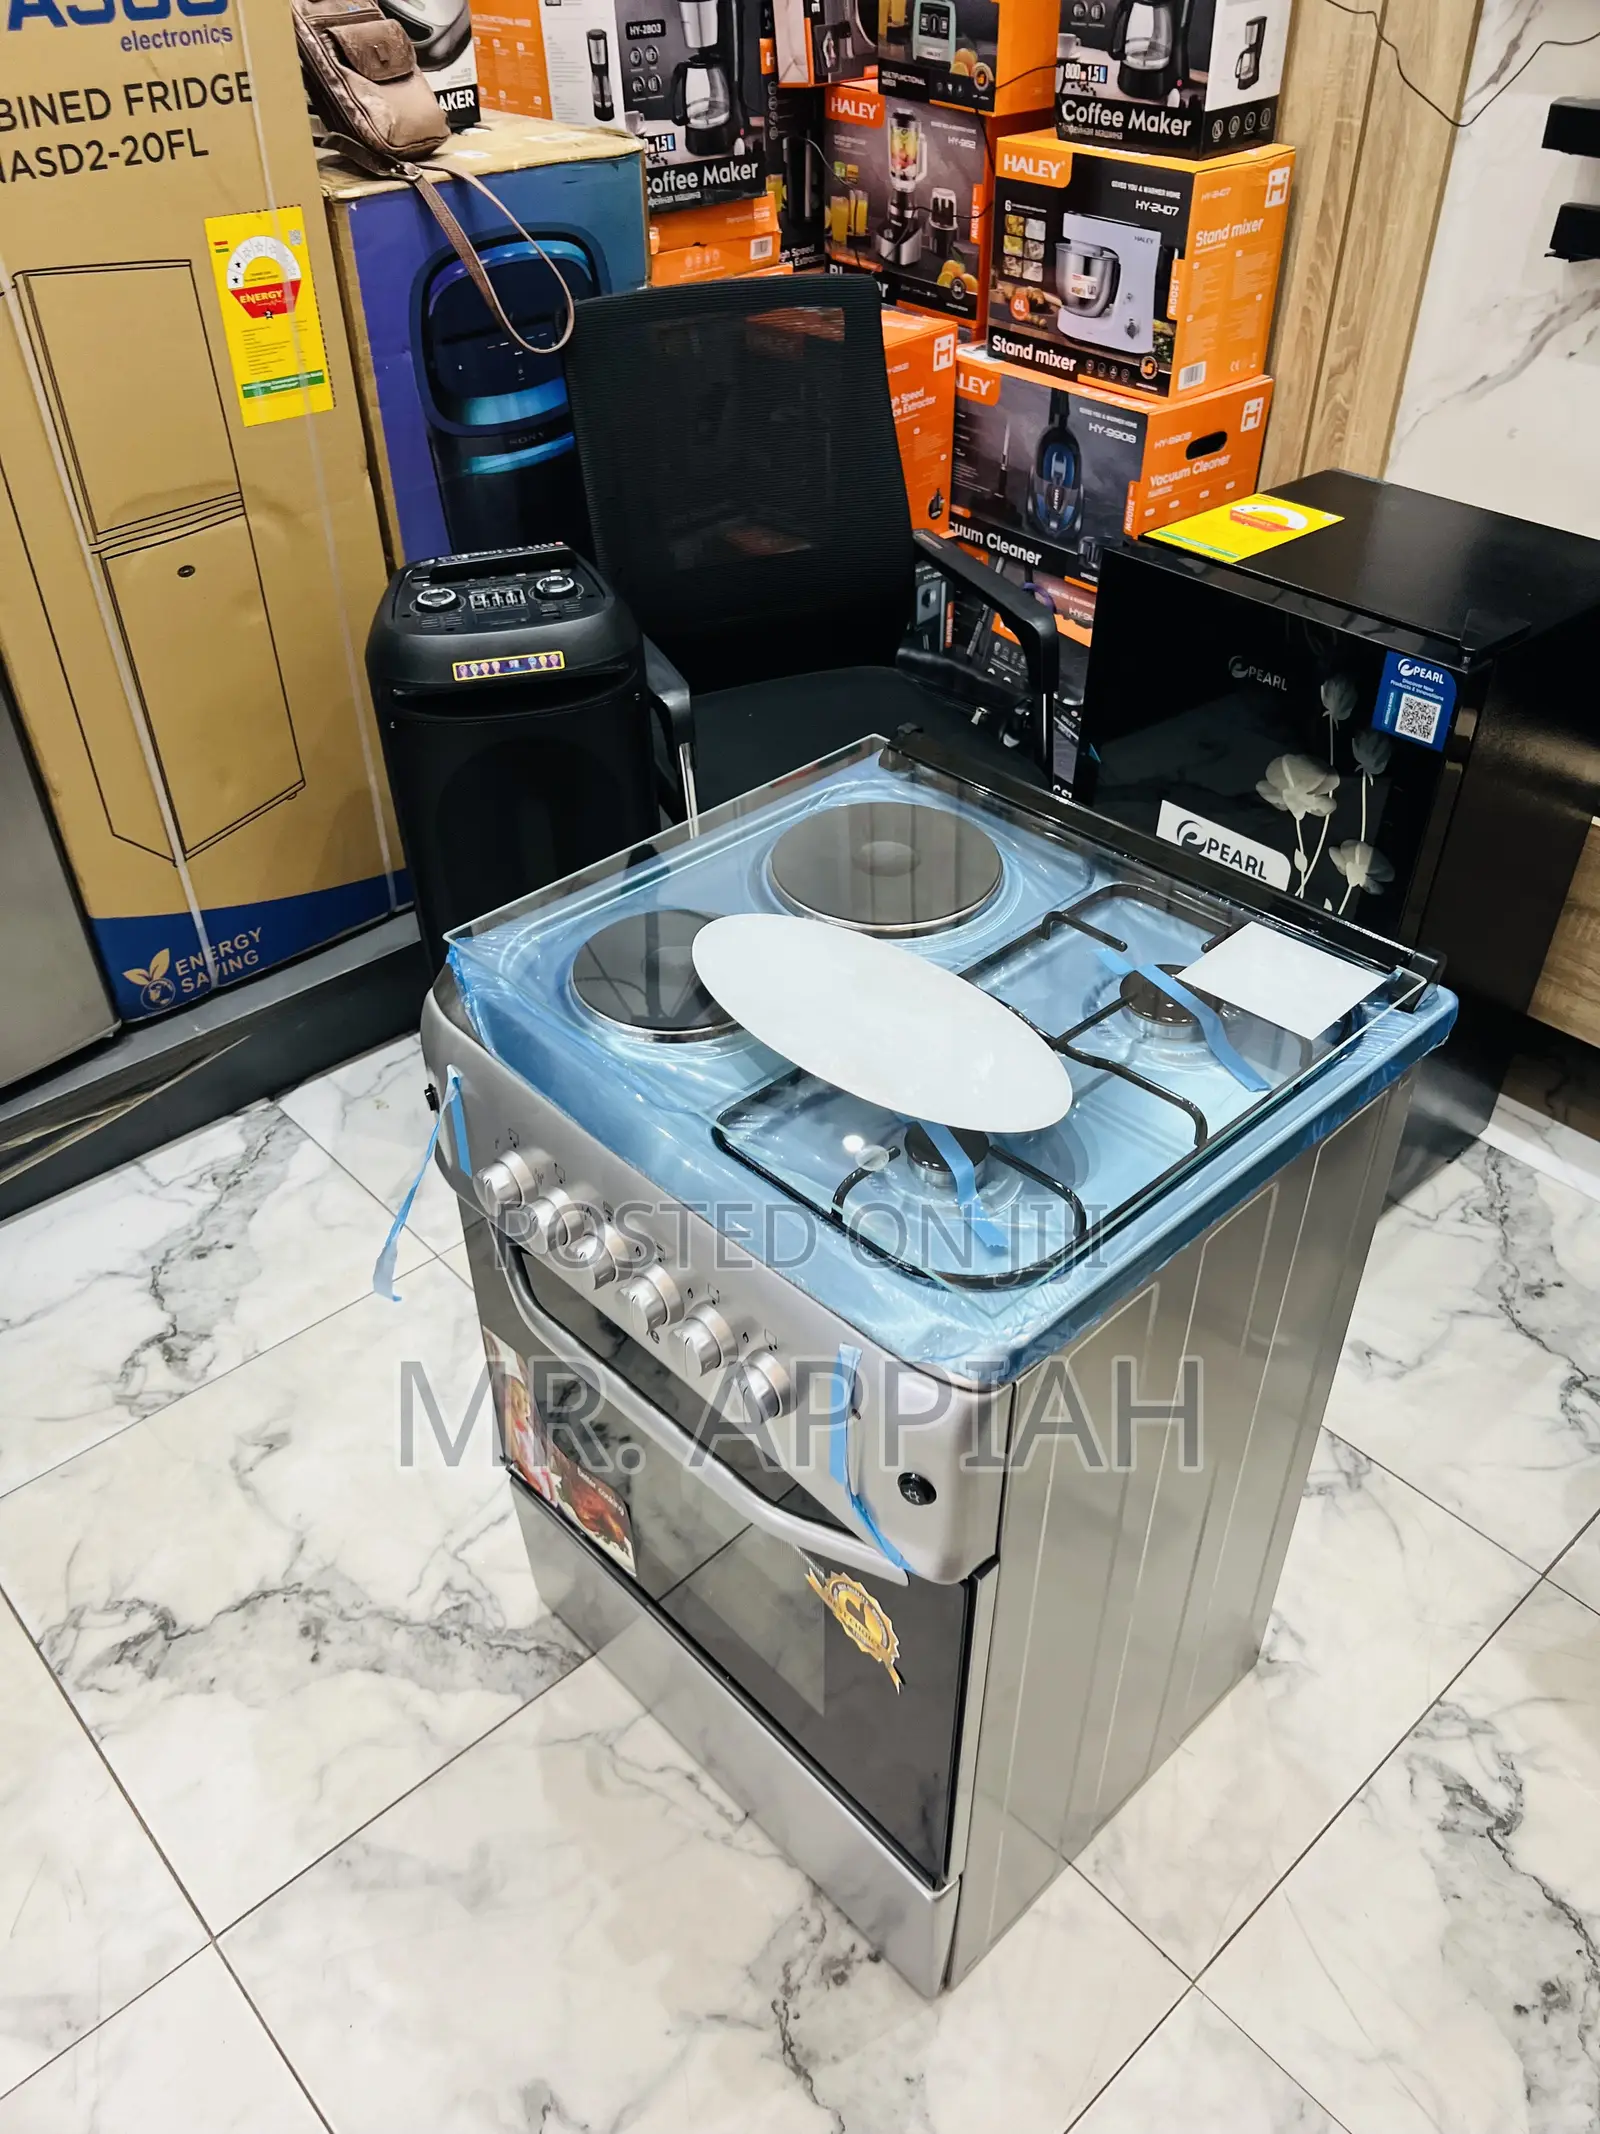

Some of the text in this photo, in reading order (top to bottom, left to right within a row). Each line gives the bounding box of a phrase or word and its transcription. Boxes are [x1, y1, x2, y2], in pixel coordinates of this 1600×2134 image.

[120, 24, 233, 52] electronics
[123, 71, 253, 116] FRIDGE
[831, 97, 877, 120] HALEY
[1062, 100, 1192, 137] Coffee Maker
[0, 128, 209, 184] ASD2-20FL
[1003, 153, 1061, 180] HALEY
[703, 161, 759, 186] Maker
[1004, 200, 1012, 212] 6
[1135, 199, 1180, 216] HY-2407
[1196, 218, 1264, 247] Stand mixer
[239, 290, 283, 304] ENERGY
[992, 334, 1077, 372] Stand mixer
[956, 373, 990, 396] LEY
[1150, 454, 1231, 487] Vacuum Cleaner
[986, 533, 1042, 566] Cleaner
[1248, 665, 1288, 692] PEARL
[1413, 665, 1445, 685] PEARL
[1206, 837, 1267, 880] PEARL
[175, 927, 262, 976] ENERGY
